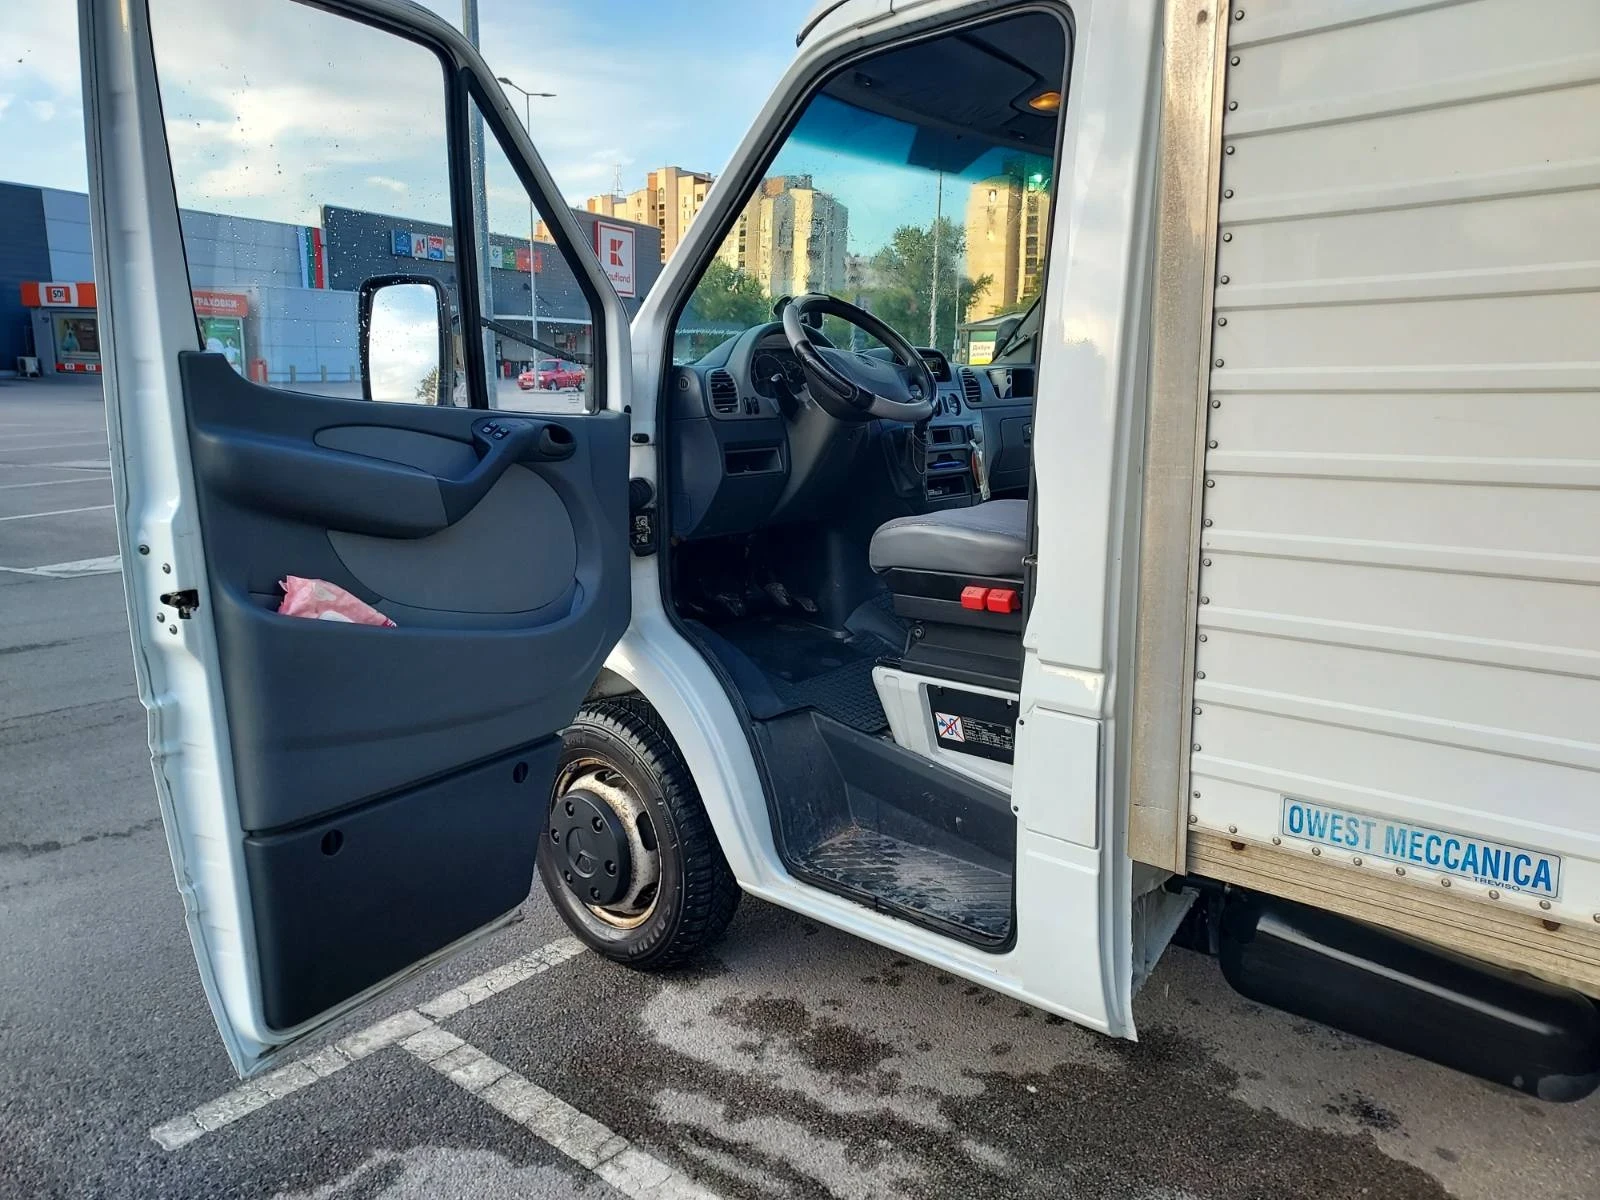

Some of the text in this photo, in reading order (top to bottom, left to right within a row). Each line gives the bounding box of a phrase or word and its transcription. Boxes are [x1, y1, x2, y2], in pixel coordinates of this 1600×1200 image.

[610, 239, 624, 267] K
[607, 271, 631, 283] aufland
[194, 296, 237, 308] ТРАХОВКИ
[1289, 804, 1552, 892] OWEST MECCANICA
[1474, 876, 1521, 892] TREVISO
